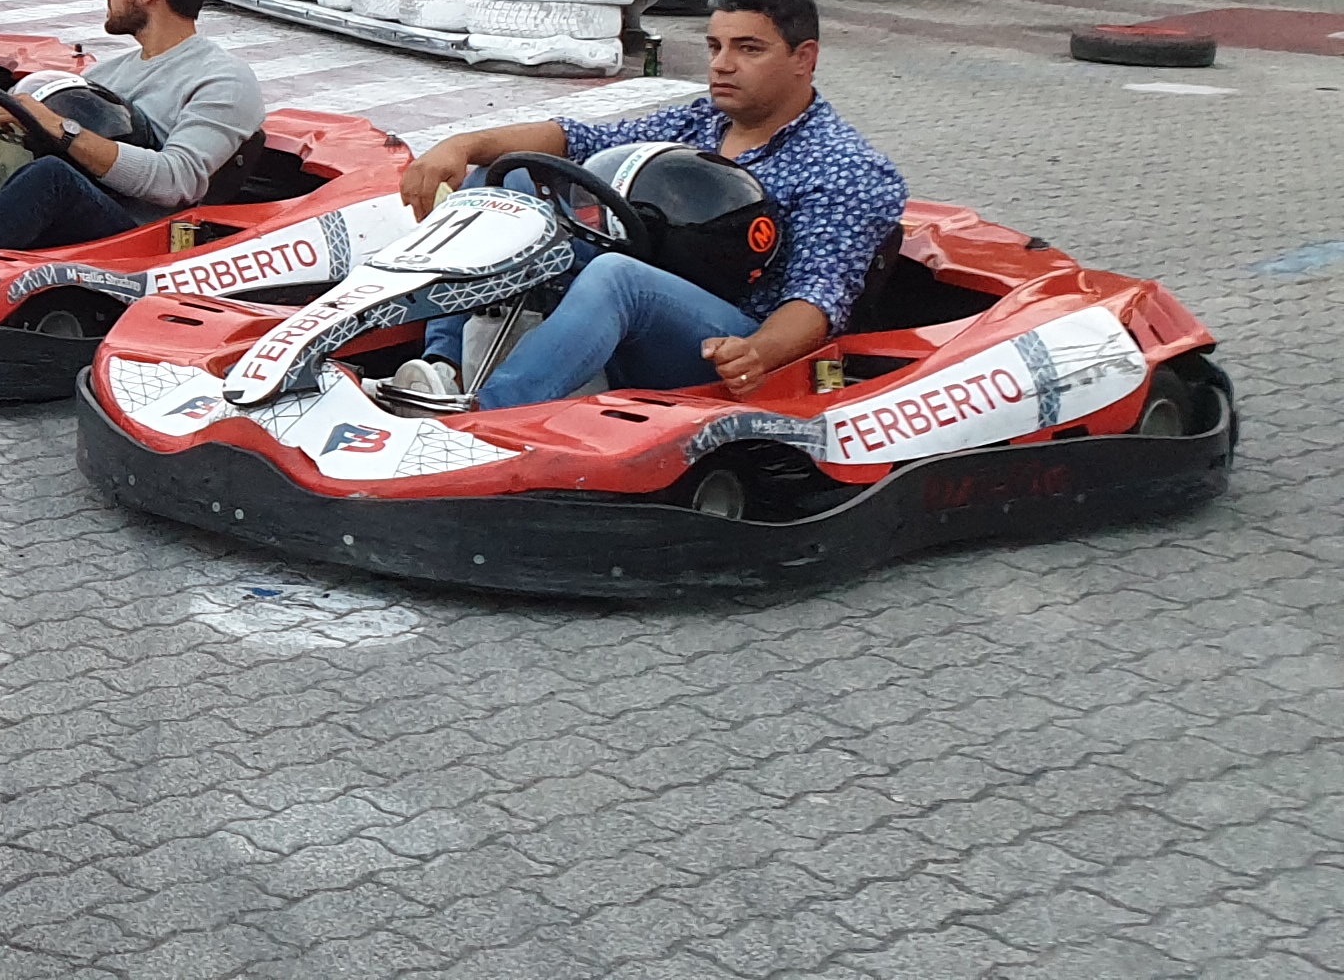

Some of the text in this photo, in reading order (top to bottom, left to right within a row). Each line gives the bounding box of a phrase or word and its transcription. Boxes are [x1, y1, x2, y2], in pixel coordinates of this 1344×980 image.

[153, 238, 319, 296] FERBERTO
[403, 209, 484, 254] 11
[241, 283, 385, 383] FERBERTO
[834, 367, 1024, 460] FERBERTO
